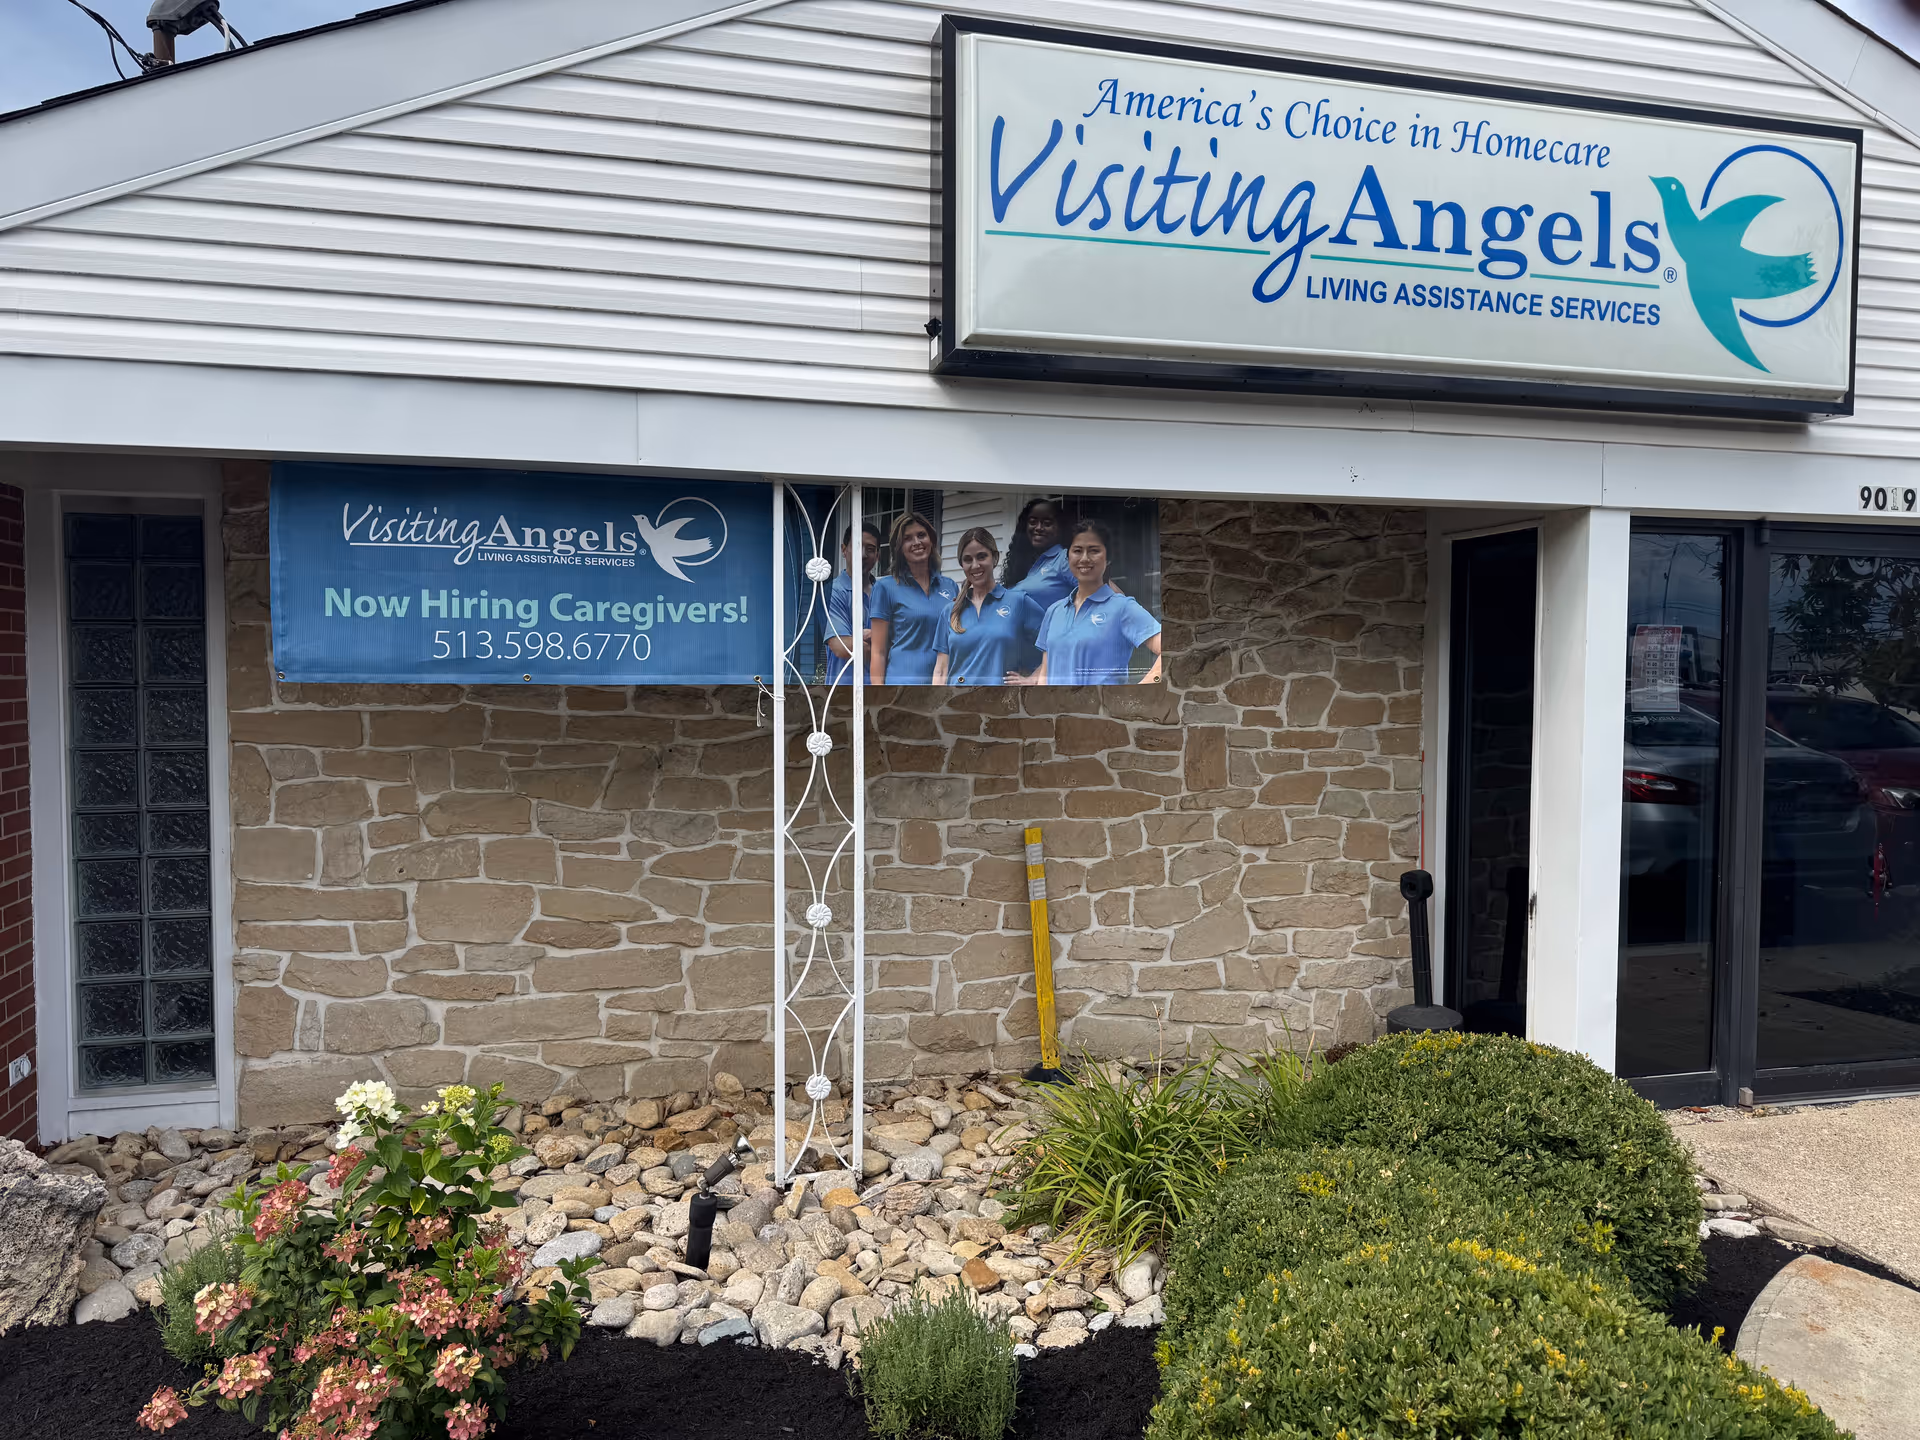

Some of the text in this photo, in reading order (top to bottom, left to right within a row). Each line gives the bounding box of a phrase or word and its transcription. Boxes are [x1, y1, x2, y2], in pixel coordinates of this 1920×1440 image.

[1083, 78, 1611, 168] America's Choice in Homecare
[990, 115, 1661, 304] Visiting Angels
[1306, 275, 1661, 326] LIVING ASSISTANCE SERVICES
[1860, 486, 1916, 511] 9019
[342, 502, 638, 566] Visiting Angels
[477, 552, 636, 567] LIVING ASSISTANCE SERVICES
[325, 588, 748, 631] Now Hiring Caregivers!
[433, 630, 651, 661] 513.598.6770
